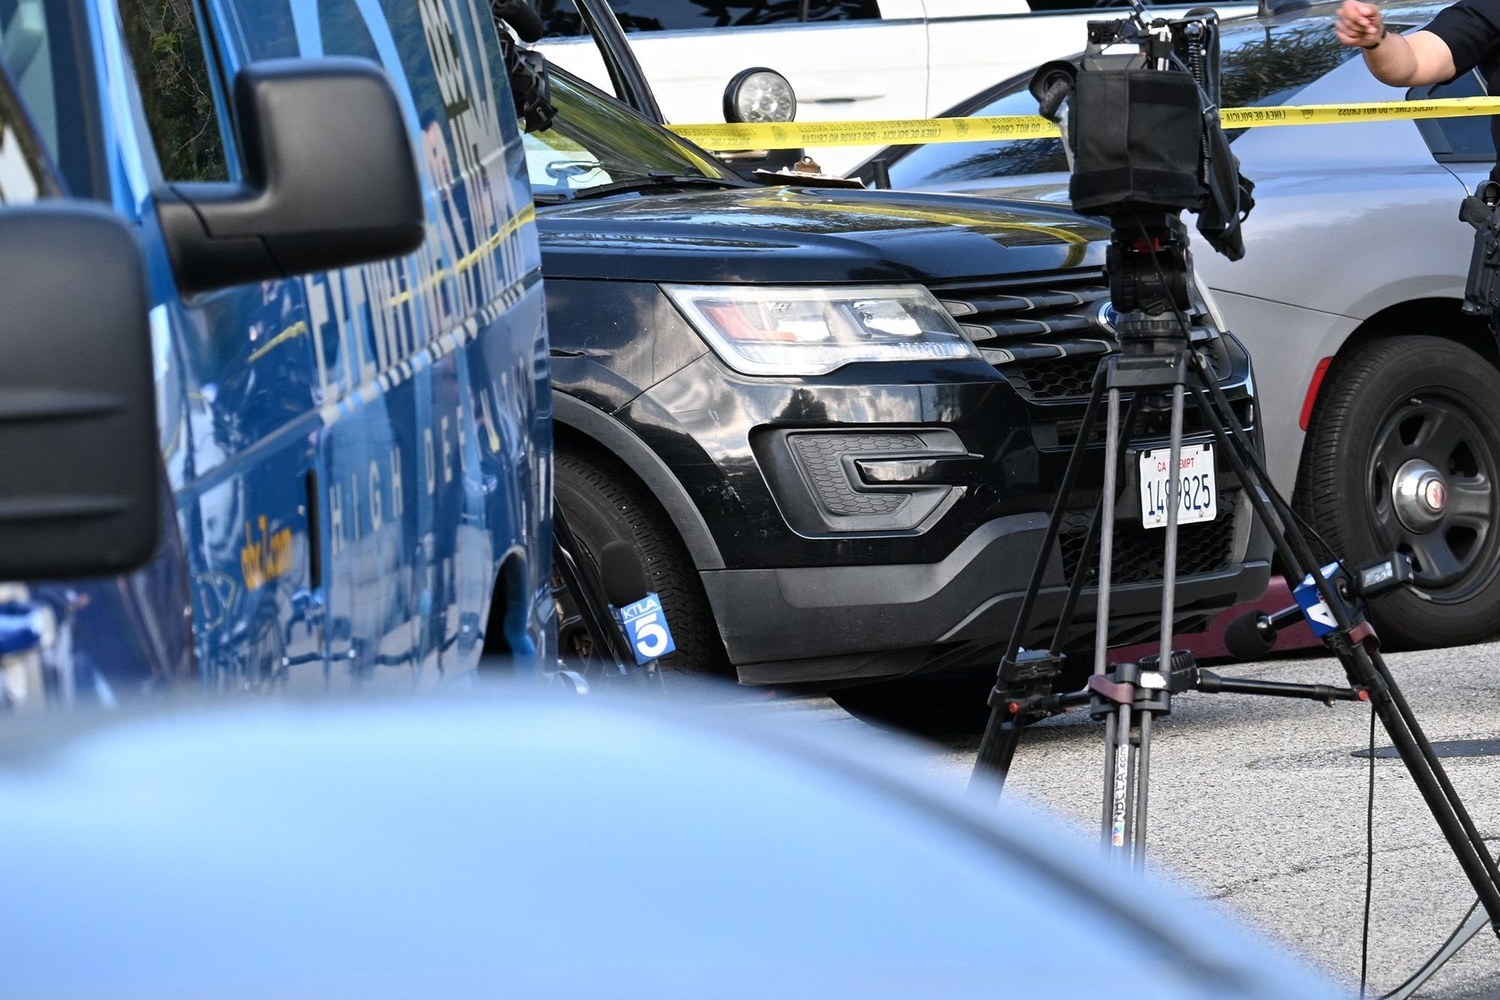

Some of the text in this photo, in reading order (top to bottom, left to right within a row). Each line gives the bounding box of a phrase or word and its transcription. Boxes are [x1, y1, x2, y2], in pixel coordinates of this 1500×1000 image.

[1156, 461, 1167, 473] CA
[328, 438, 403, 556] HIGH
[623, 598, 658, 621] KTLA
[635, 612, 668, 658] 5
